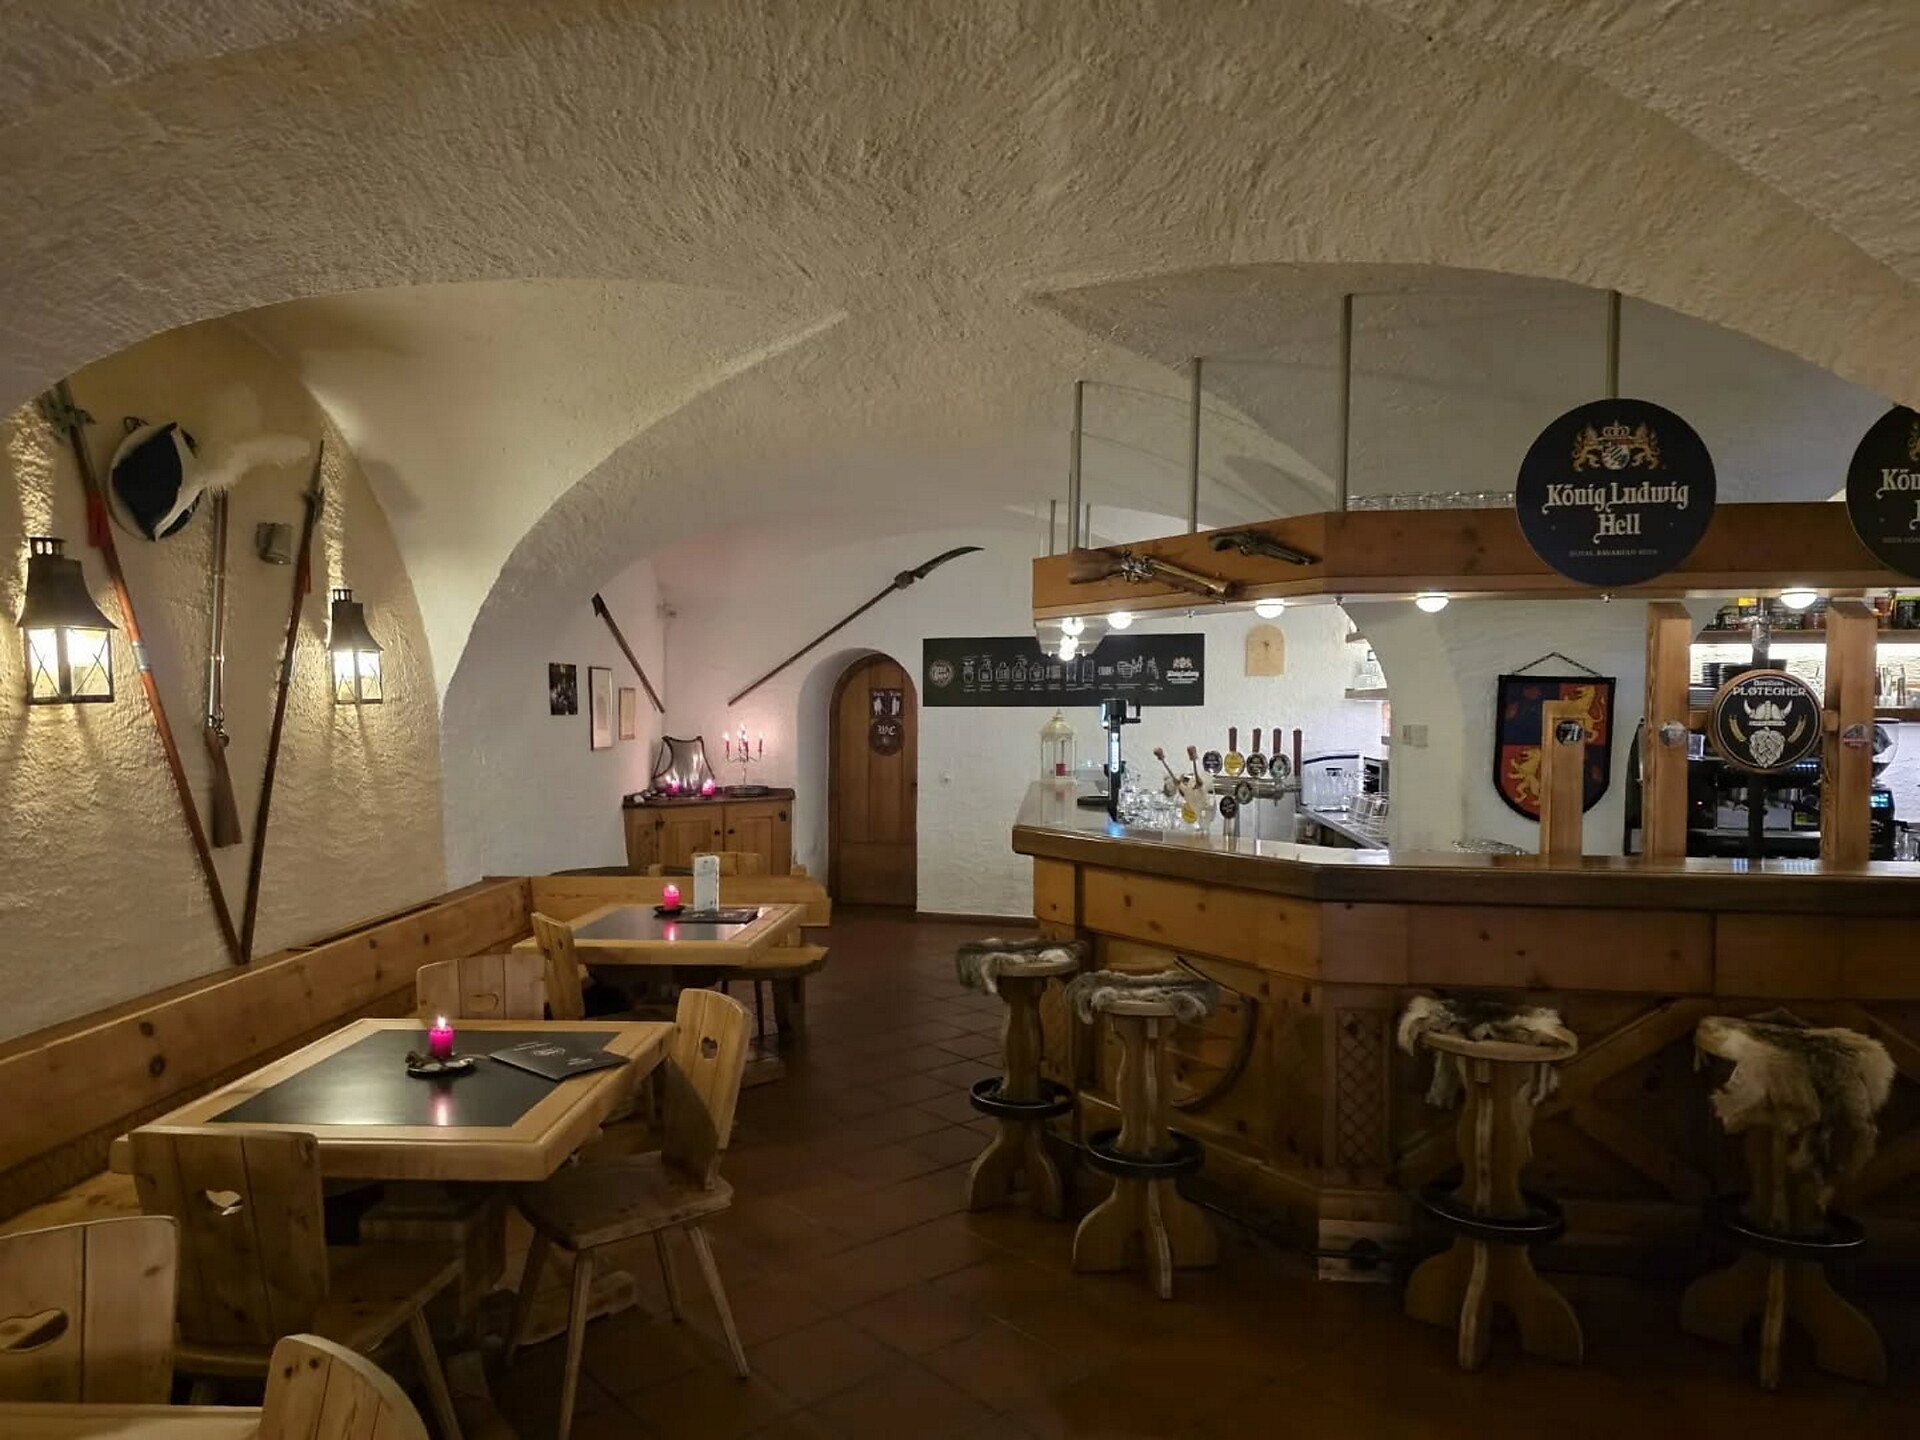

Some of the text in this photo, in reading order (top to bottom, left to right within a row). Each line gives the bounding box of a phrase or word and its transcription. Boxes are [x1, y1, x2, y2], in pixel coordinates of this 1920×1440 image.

[1541, 481, 1690, 514] König Ludwig
[1592, 513, 1642, 544] Hell
